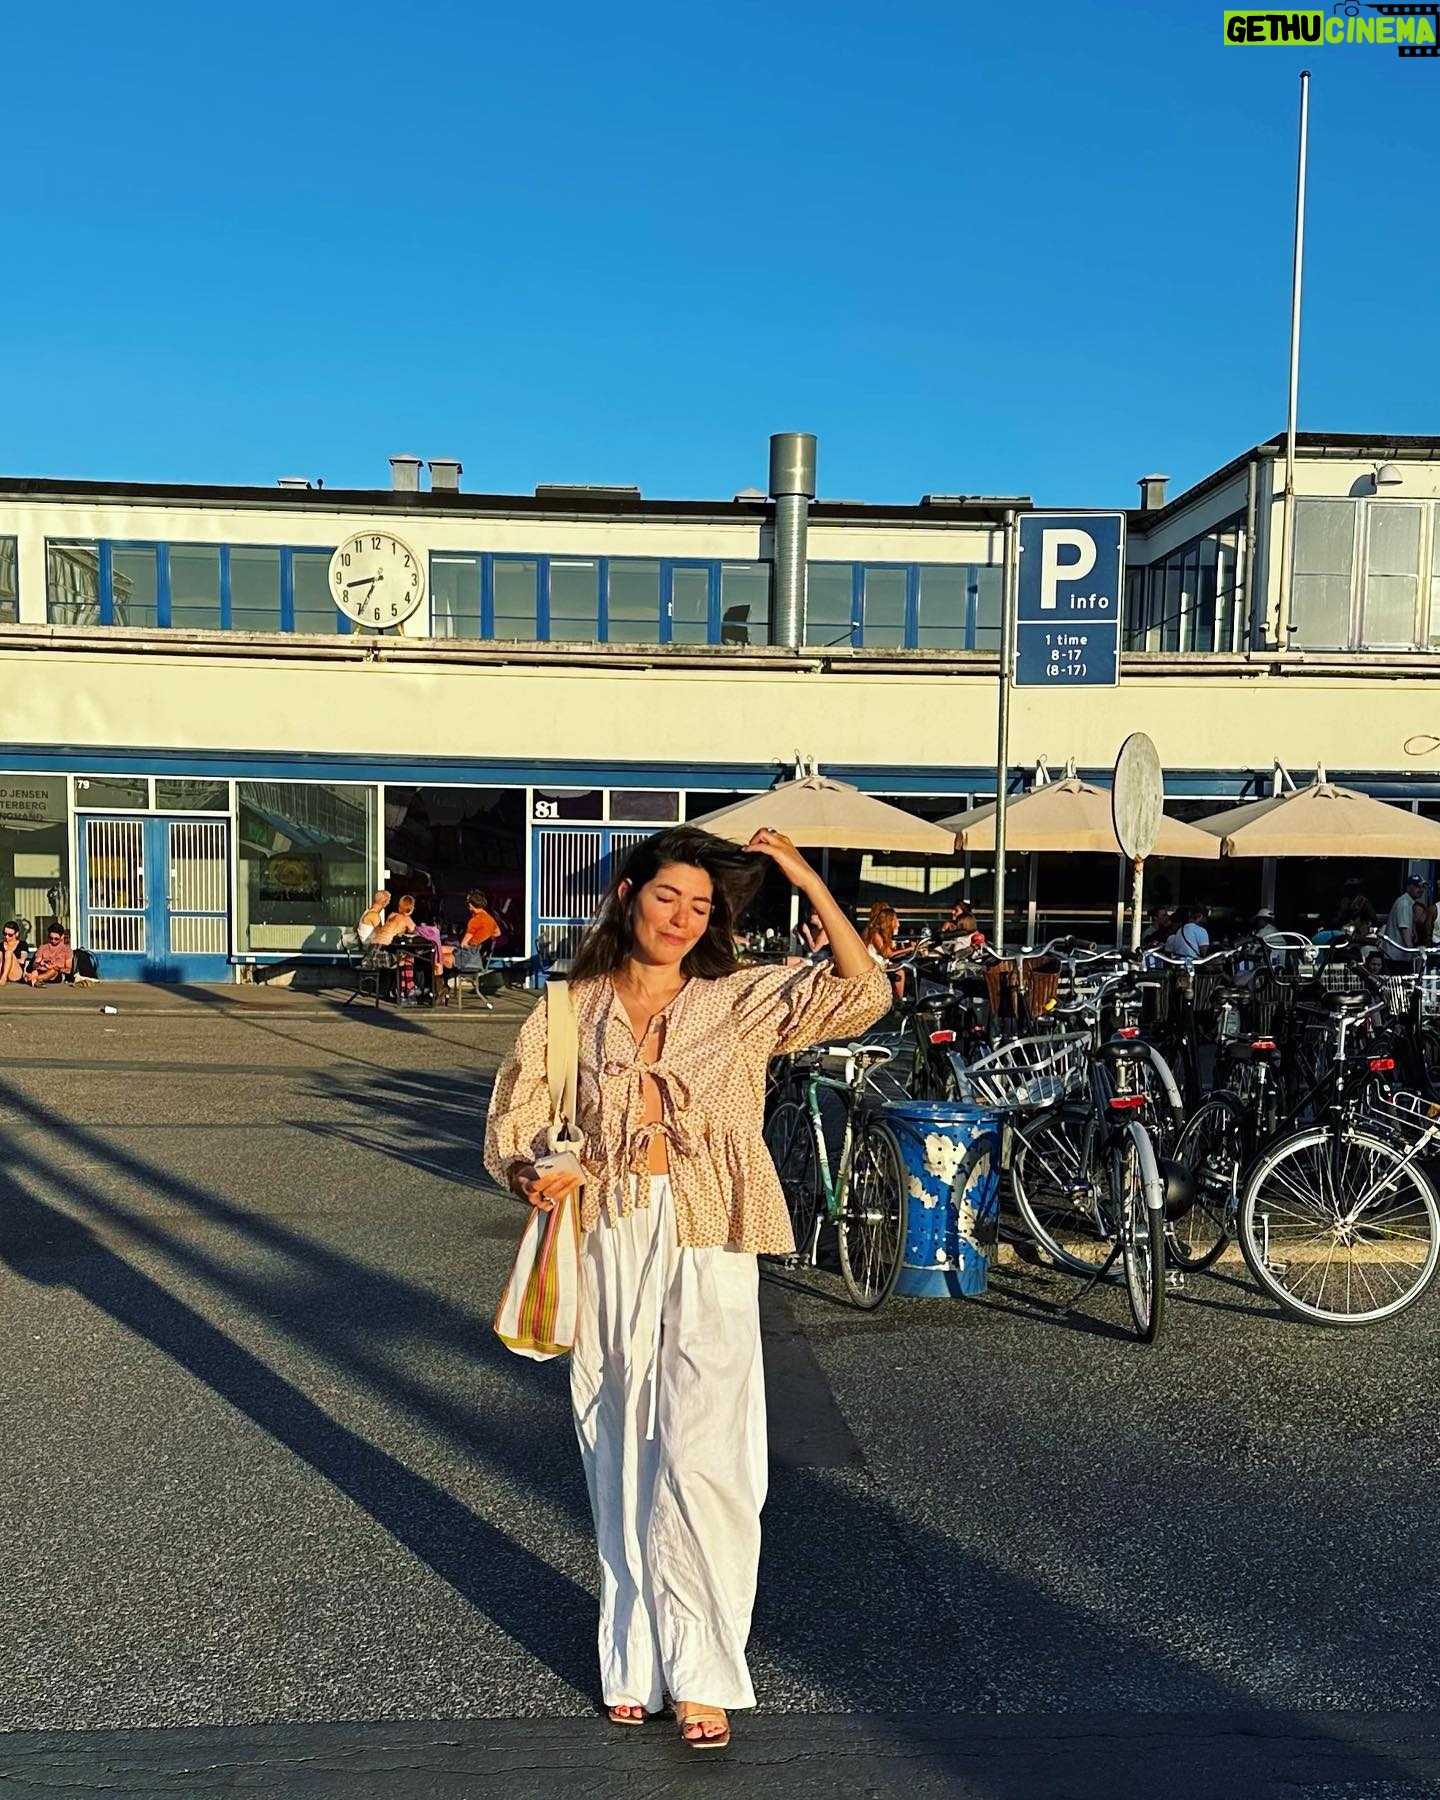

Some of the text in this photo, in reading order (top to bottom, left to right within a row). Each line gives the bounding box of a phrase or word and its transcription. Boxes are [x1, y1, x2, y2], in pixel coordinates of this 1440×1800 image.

[355, 540, 363, 553] 11
[371, 537, 381, 550] 12
[392, 542, 396, 555] 1
[341, 553, 351, 567] 10
[404, 554, 410, 568] 2
[1040, 528, 1109, 610] P info
[336, 571, 342, 584] 9
[411, 573, 418, 586] 3
[342, 590, 349, 603] 8
[404, 591, 411, 604] 4
[356, 602, 362, 616] 7
[374, 607, 380, 621] 6
[391, 603, 398, 617] 5
[1045, 634, 1088, 645] 1 time
[1051, 649, 1082, 661] 8-17
[1046, 664, 1087, 677] (8-17)
[77, 780, 90, 790] 79
[9, 789, 49, 799] JENSEN
[535, 800, 560, 818] 81
